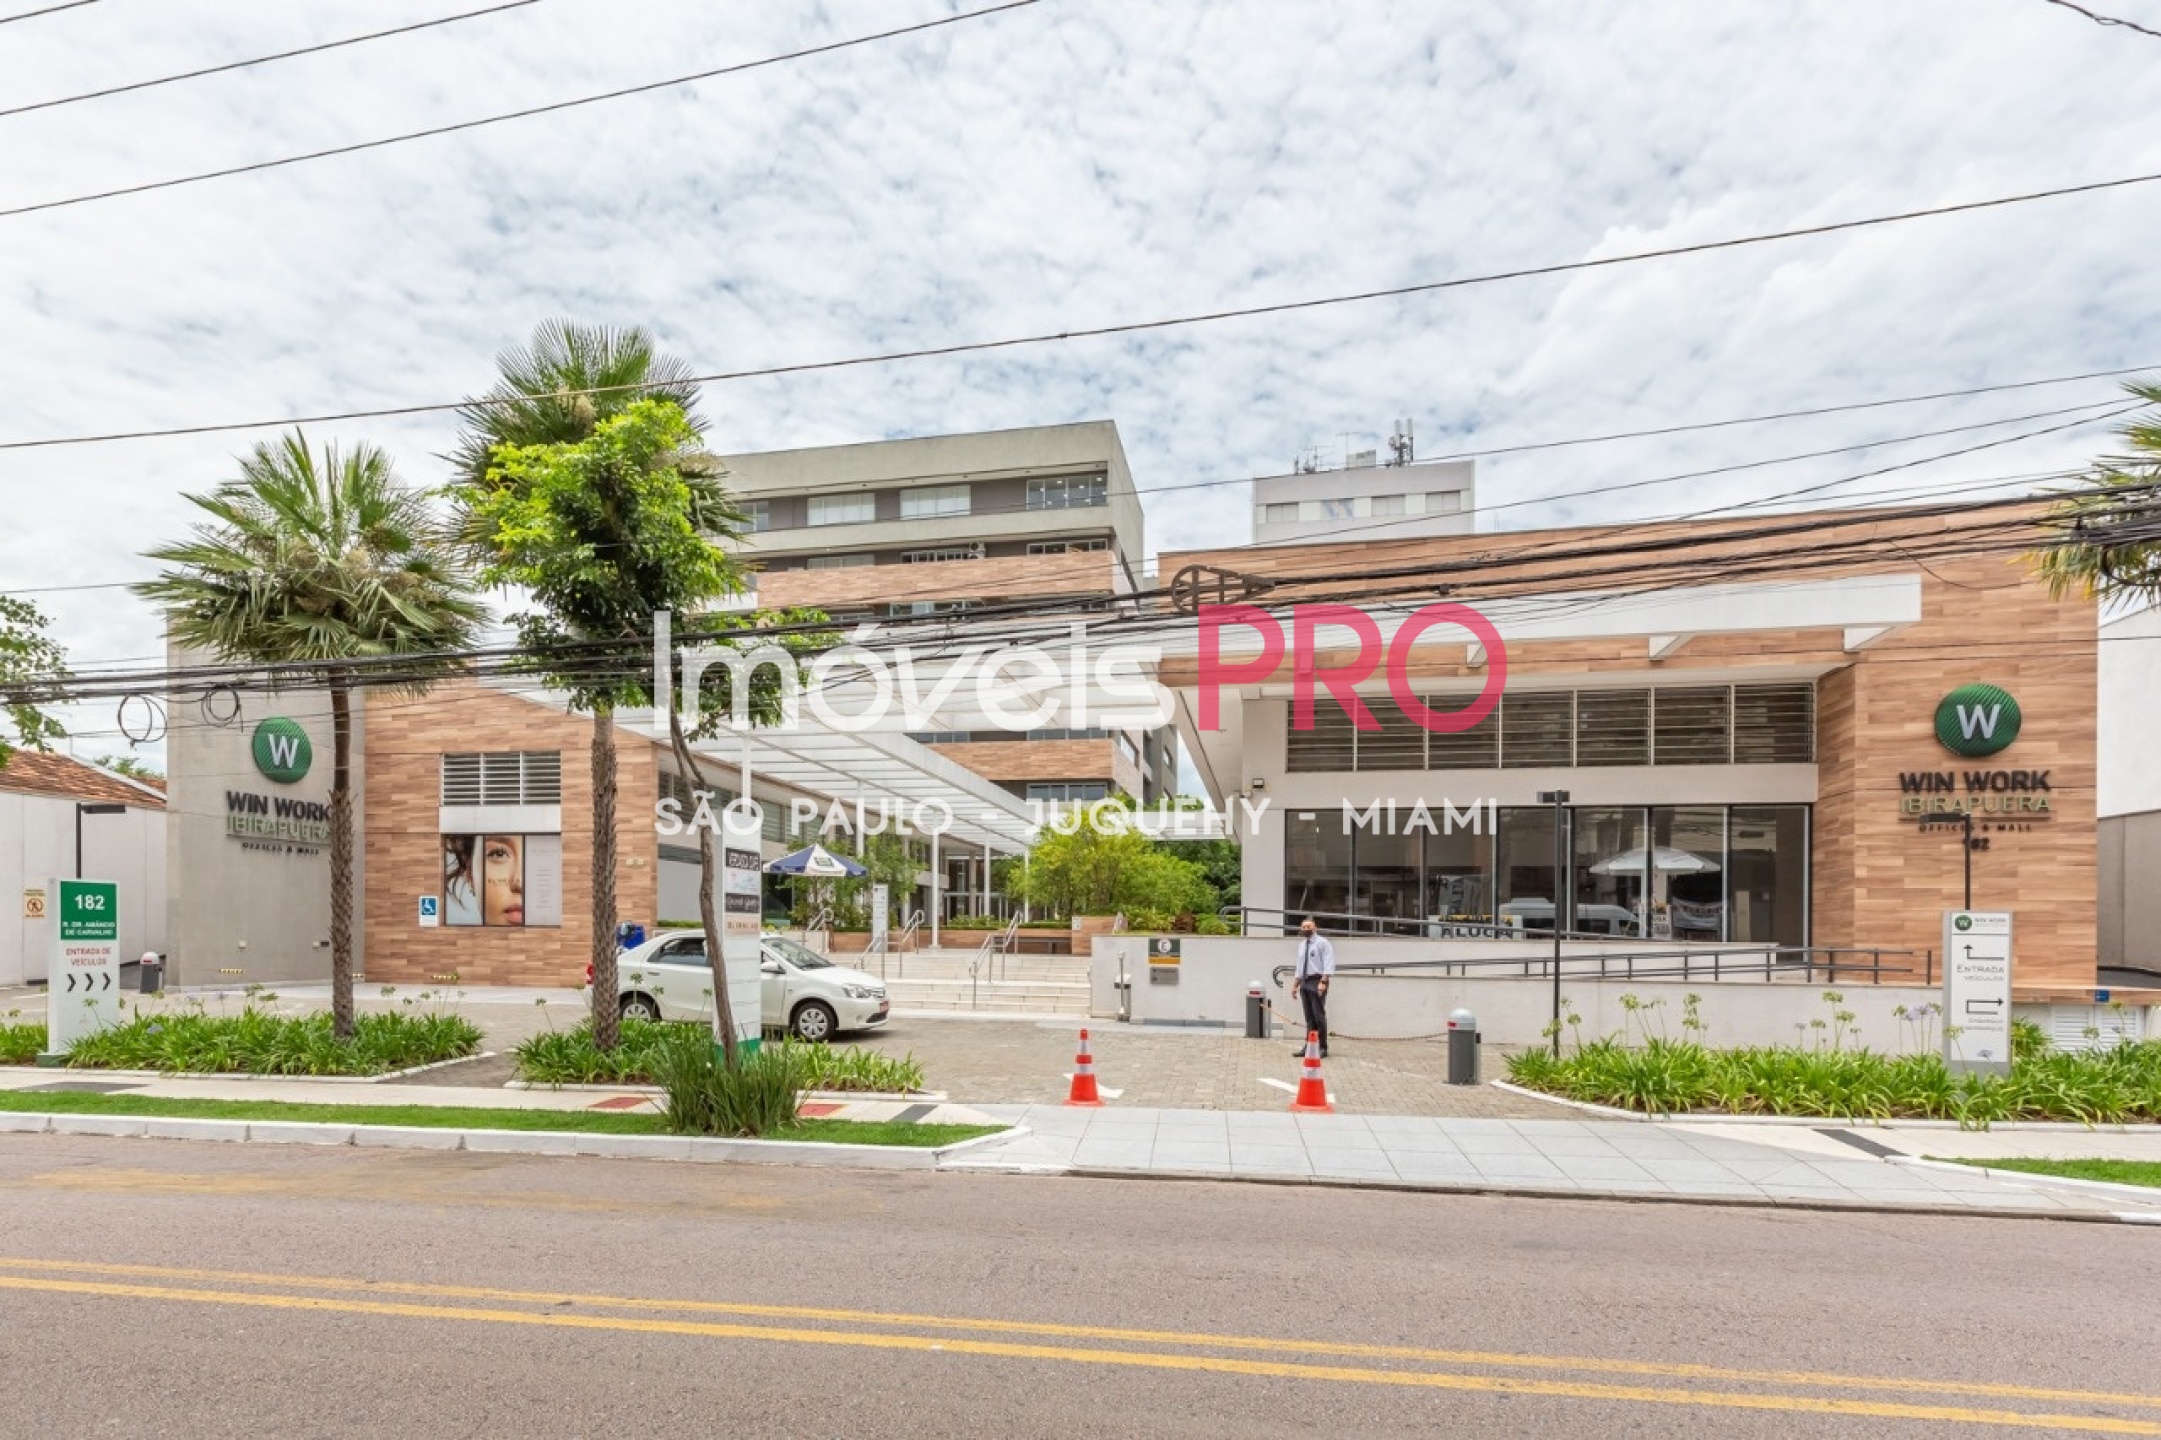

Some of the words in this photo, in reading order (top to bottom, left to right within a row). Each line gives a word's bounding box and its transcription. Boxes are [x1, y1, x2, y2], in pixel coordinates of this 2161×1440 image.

[1957, 703, 2001, 740] W
[268, 733, 299, 769] W
[1900, 772, 1955, 793] WIN
[1963, 770, 2051, 792] WORK
[226, 790, 269, 816] WIN
[274, 797, 332, 821] WORK
[1901, 796, 2050, 813] IBIRAPUERA
[75, 894, 105, 910] 182
[66, 948, 100, 956] ENTRADA
[1956, 964, 2004, 973] ENTRADA
